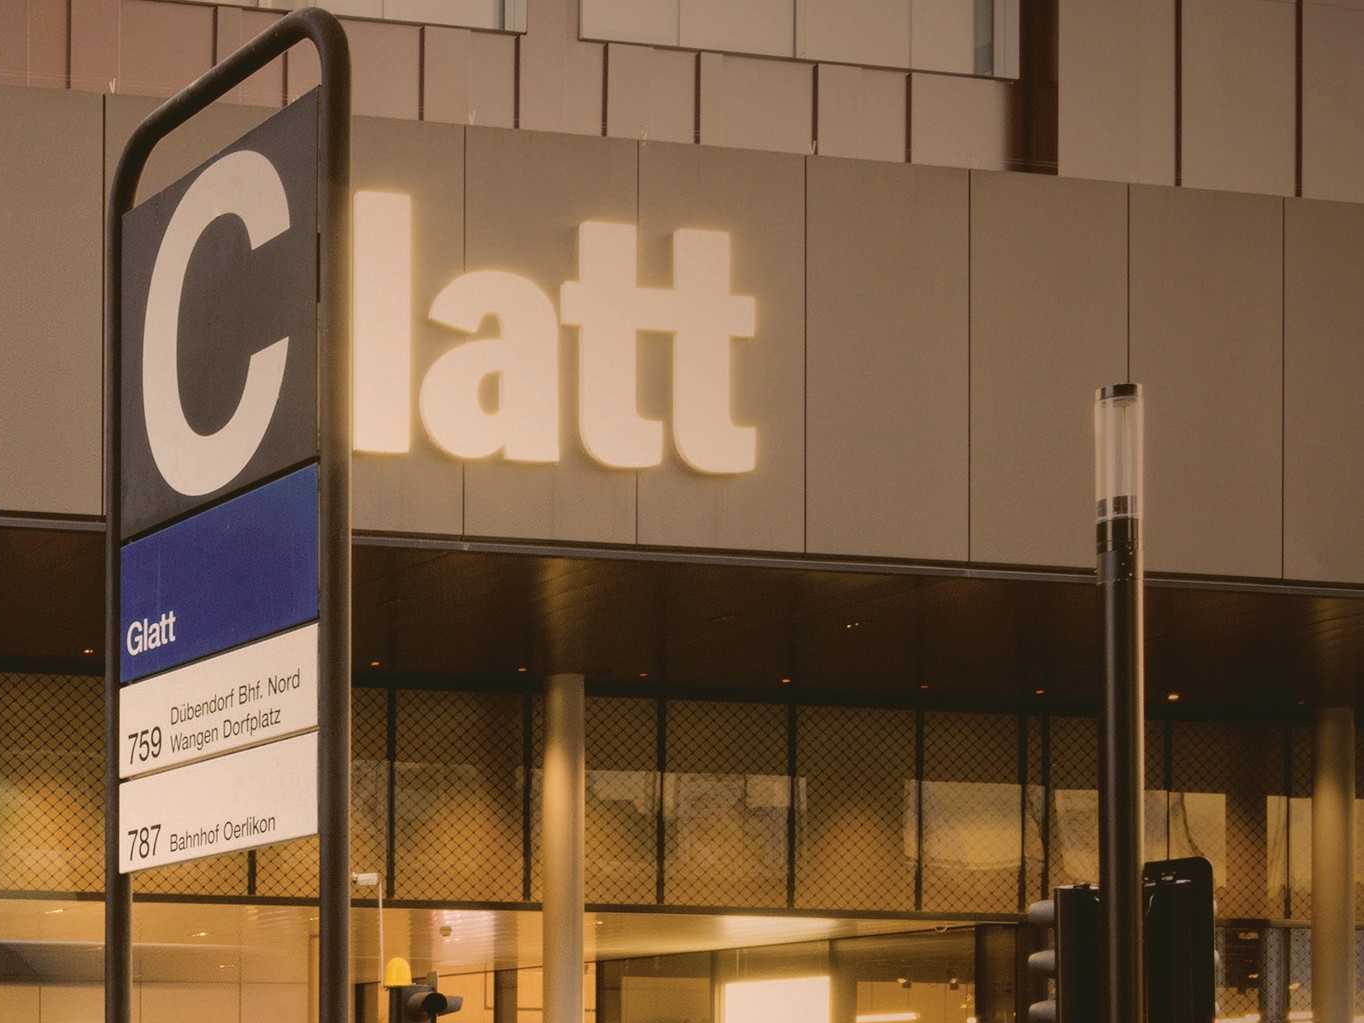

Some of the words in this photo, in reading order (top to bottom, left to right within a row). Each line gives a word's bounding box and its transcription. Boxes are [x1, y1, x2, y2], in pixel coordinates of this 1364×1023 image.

[142, 149, 291, 497] C
[352, 190, 757, 475] latt
[126, 610, 176, 656] Glatt
[170, 690, 235, 725] Dübendorf
[238, 681, 263, 705] Bhf.
[267, 668, 301, 697] Nord
[128, 726, 162, 765] 759
[170, 726, 219, 753] Wangen
[223, 708, 281, 738] Dorfplatz
[127, 823, 162, 861] 787
[169, 824, 219, 852] Bahnhof
[223, 816, 276, 841] Oerlikon
